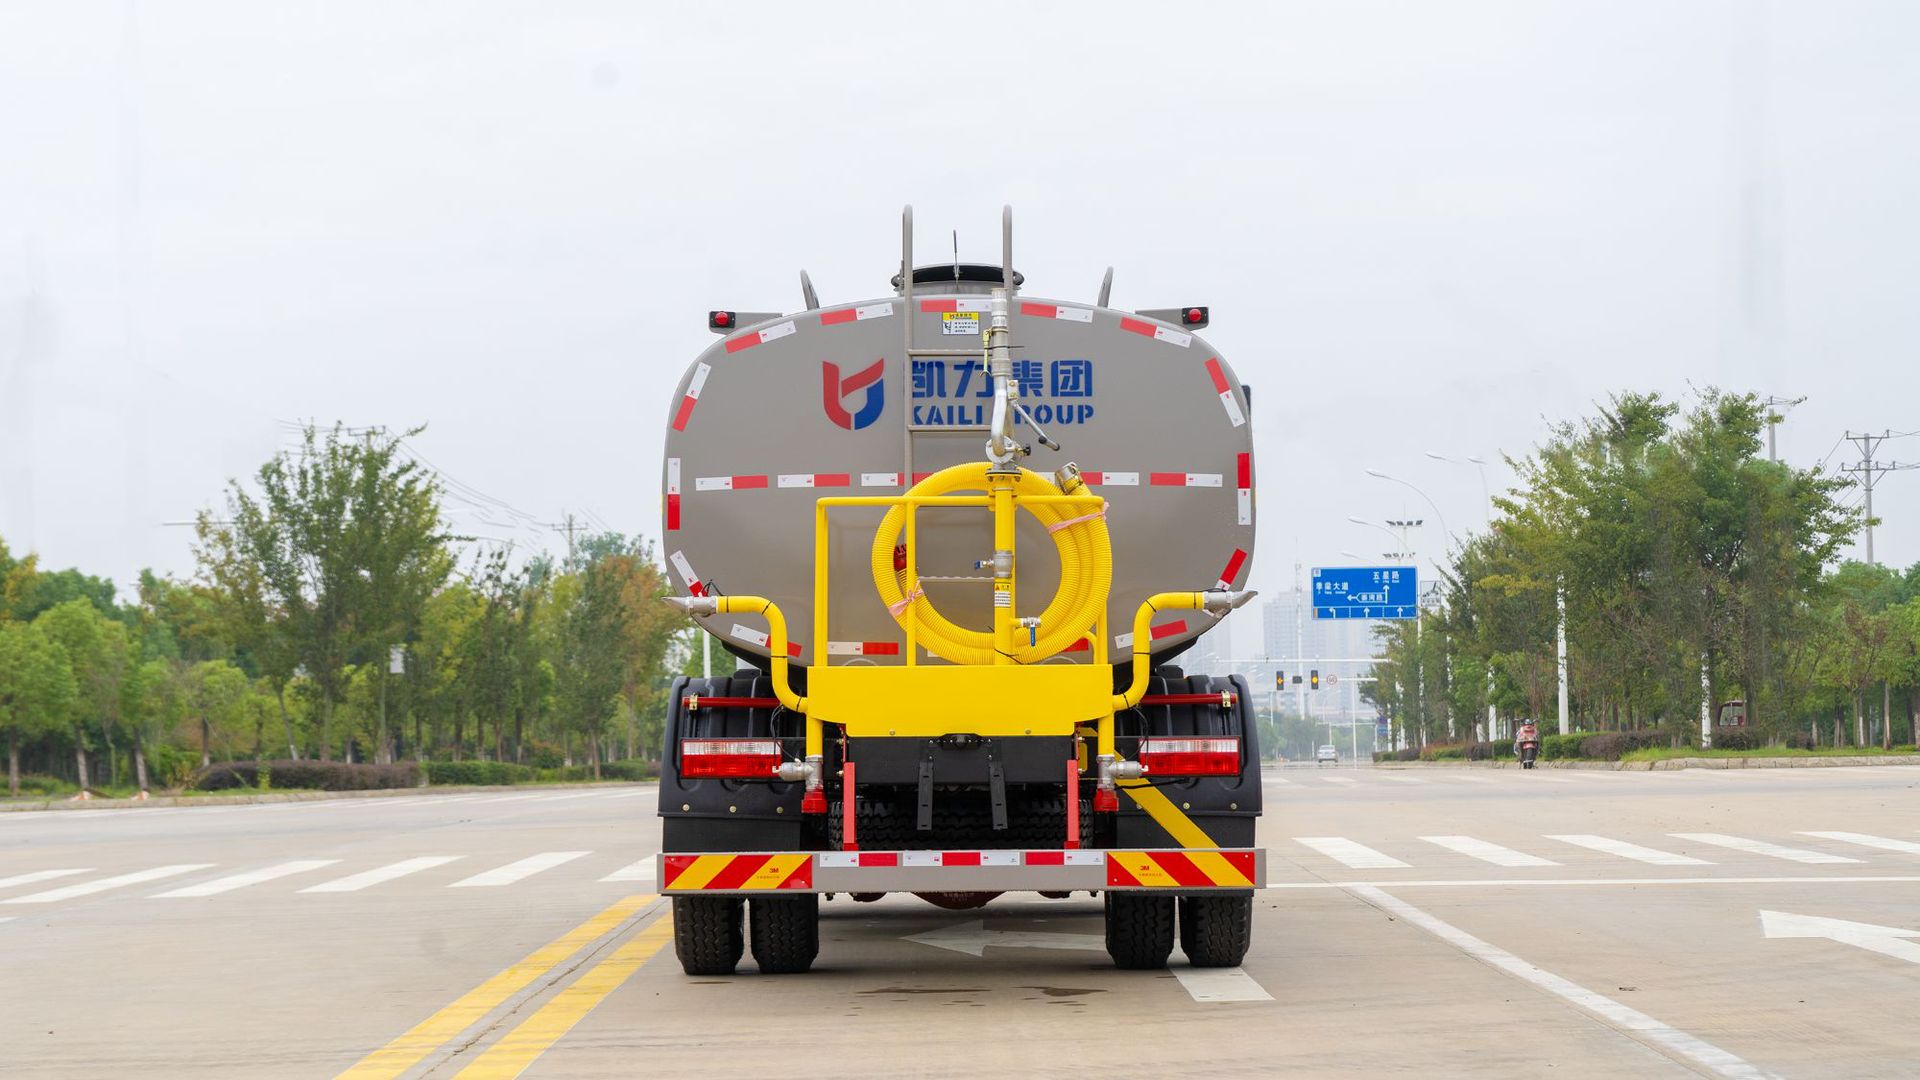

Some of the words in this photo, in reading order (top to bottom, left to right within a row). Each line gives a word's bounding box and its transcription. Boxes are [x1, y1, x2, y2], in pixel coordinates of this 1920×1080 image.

[912, 360, 1093, 398] 凯力集团
[912, 405, 983, 425] KAILI
[1014, 404, 1094, 425] ROUP
